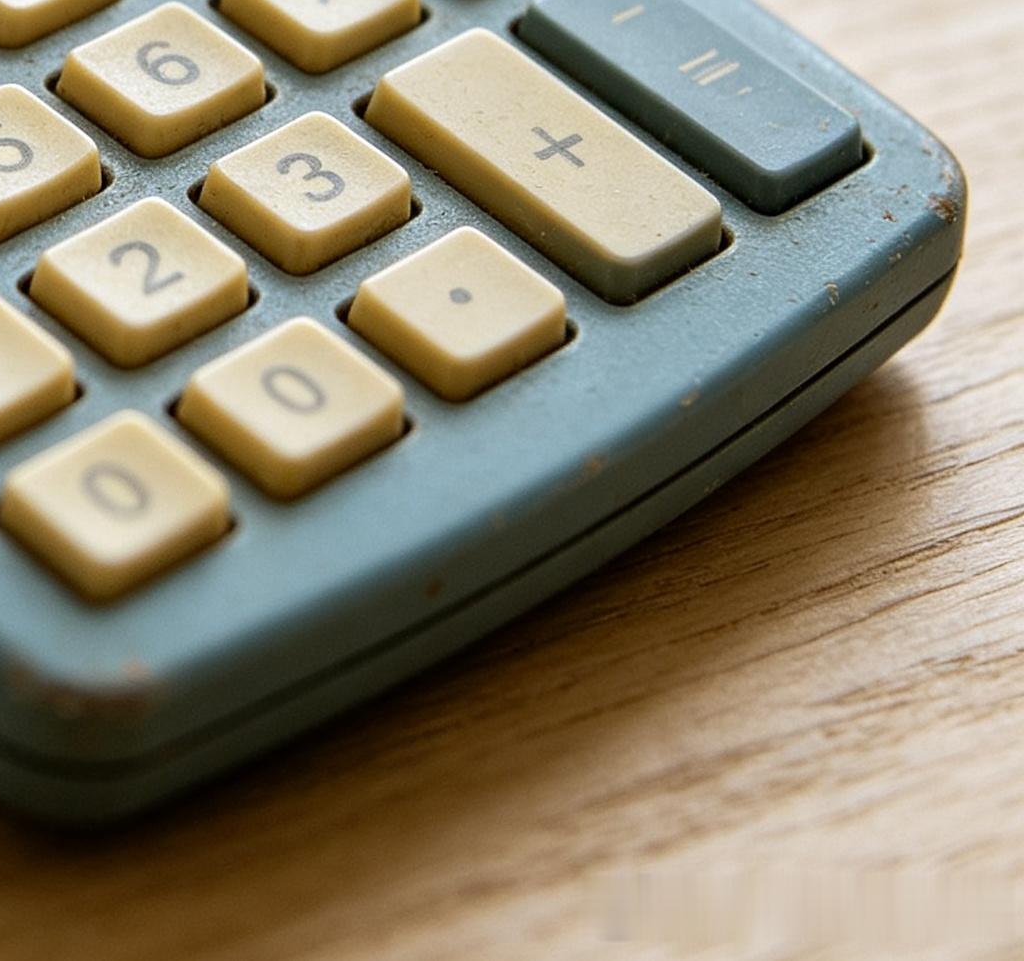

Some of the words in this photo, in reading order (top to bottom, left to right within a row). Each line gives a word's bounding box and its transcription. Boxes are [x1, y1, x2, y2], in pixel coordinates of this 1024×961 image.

[135, 40, 200, 86] 6
[276, 151, 345, 203] 3
[108, 240, 184, 296] 2
[260, 364, 326, 416] 0
[81, 461, 153, 520] 0
